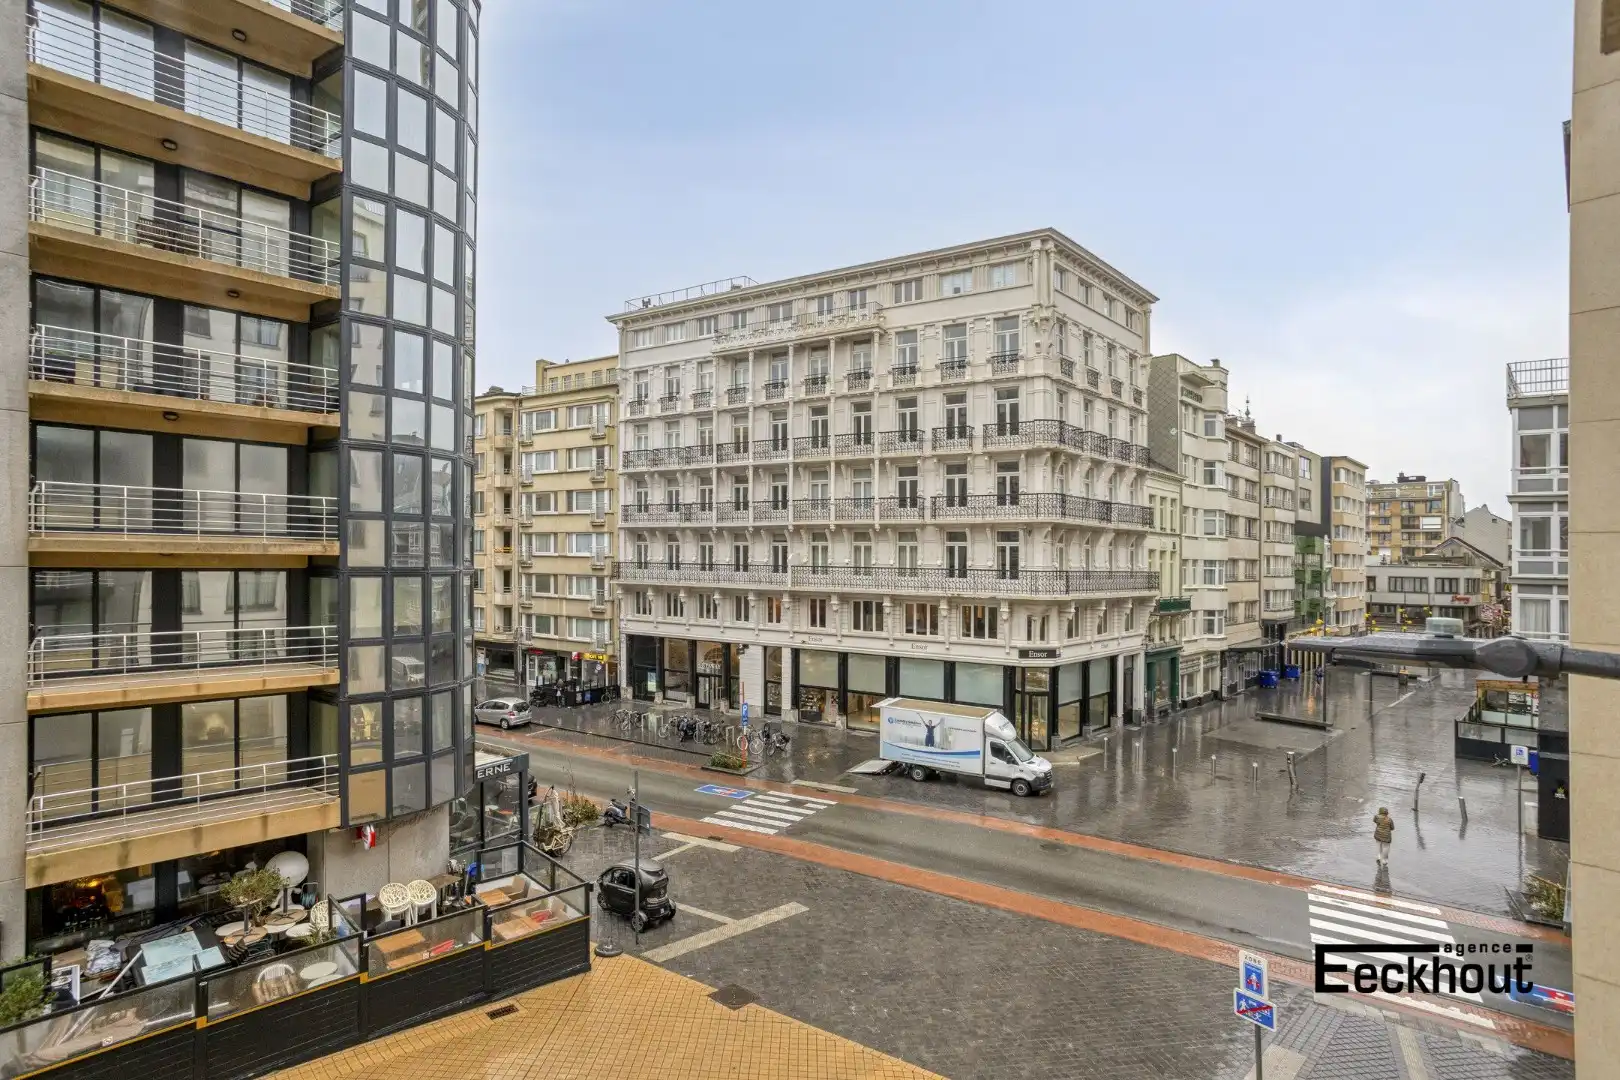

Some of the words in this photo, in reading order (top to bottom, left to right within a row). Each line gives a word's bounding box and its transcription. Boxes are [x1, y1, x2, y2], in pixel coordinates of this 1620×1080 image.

[1028, 650, 1048, 658] Ensor
[477, 762, 511, 779] ERNE
[1244, 954, 1263, 964] ZONE
